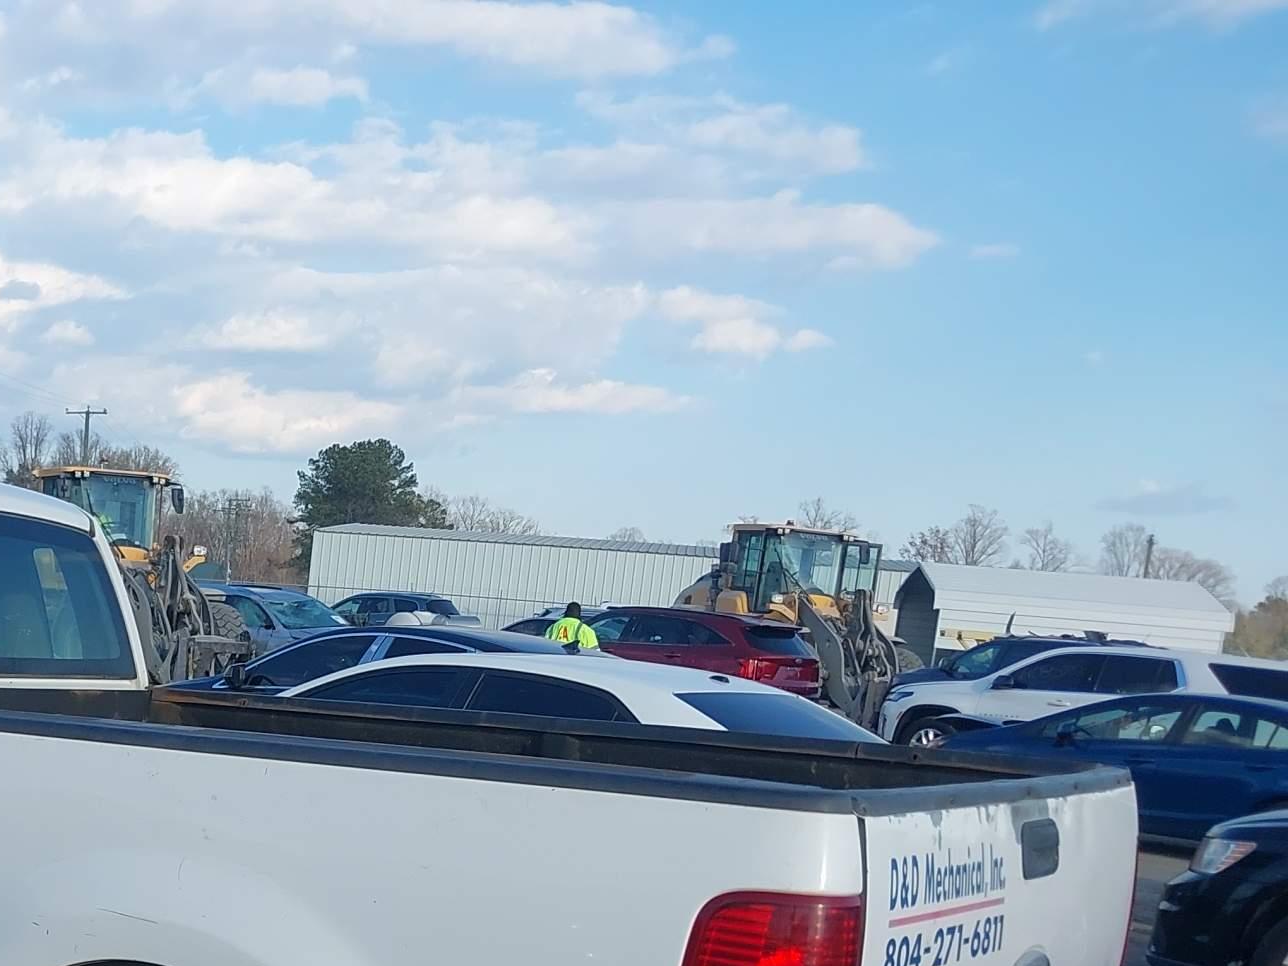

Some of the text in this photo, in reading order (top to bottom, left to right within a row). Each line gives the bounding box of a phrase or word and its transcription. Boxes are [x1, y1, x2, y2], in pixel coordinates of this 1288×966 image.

[889, 842, 1006, 911] D&D Mechanical, Inc.
